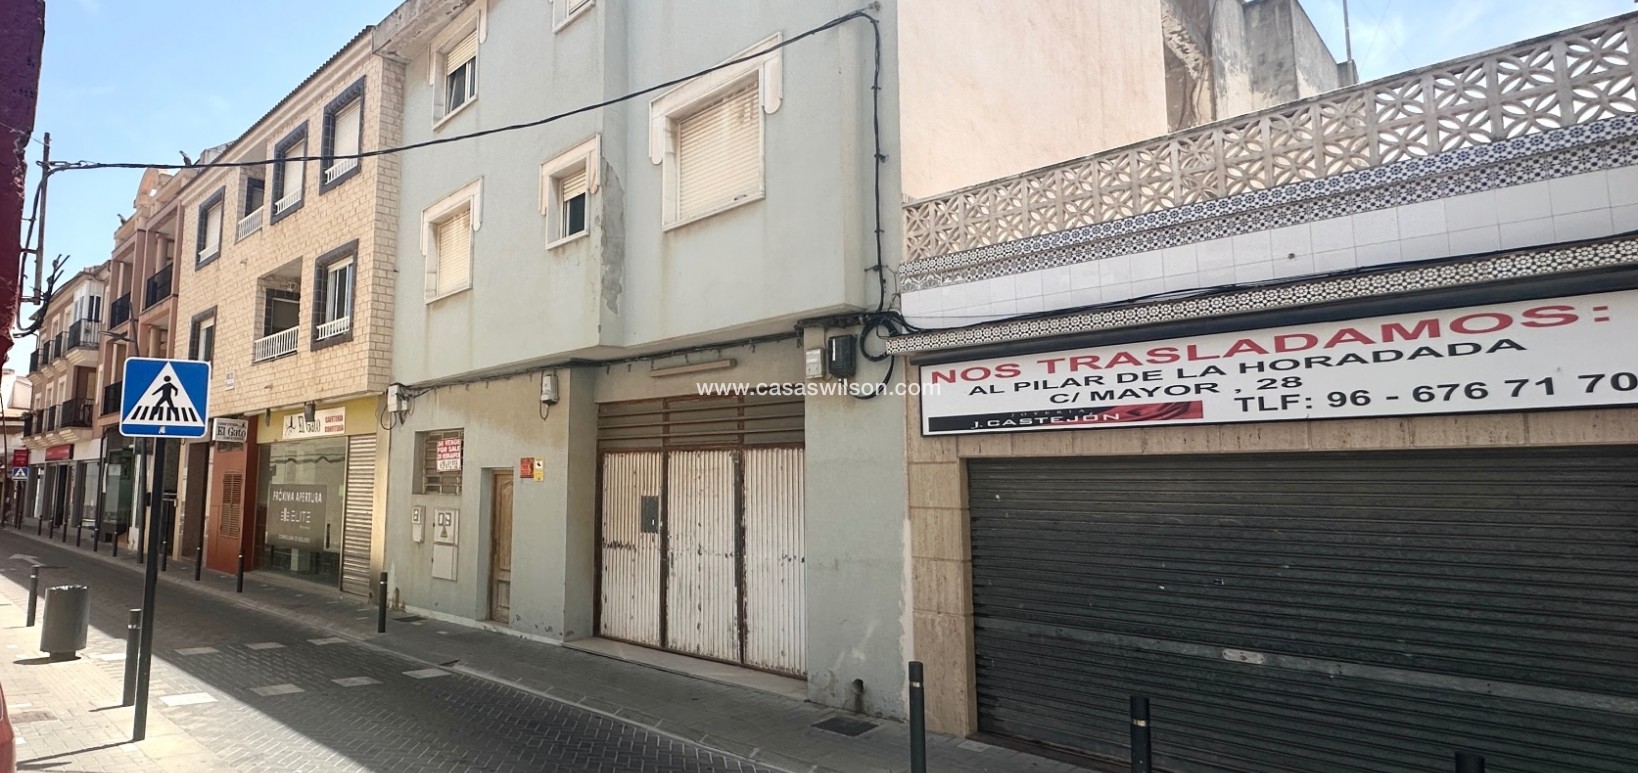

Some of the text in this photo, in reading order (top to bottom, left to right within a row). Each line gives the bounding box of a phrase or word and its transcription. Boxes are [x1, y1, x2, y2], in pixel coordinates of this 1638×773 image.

[931, 305, 1610, 385] NOS TRASLADAMOS:
[968, 338, 1528, 396] AL PILAR DE LA HORADADA
[1049, 392, 1080, 405] C/
[1090, 382, 1220, 403] MAYOR
[1256, 376, 1303, 391] 28
[1234, 394, 1313, 413] TLF:
[1327, 389, 1372, 408] 96
[1412, 382, 1489, 403] 676
[1504, 376, 1556, 398] 71
[1577, 371, 1638, 393] 70
[217, 425, 247, 439] El Gato
[987, 412, 1120, 427] CASTEJÓN
[296, 491, 323, 503] APERTURA
